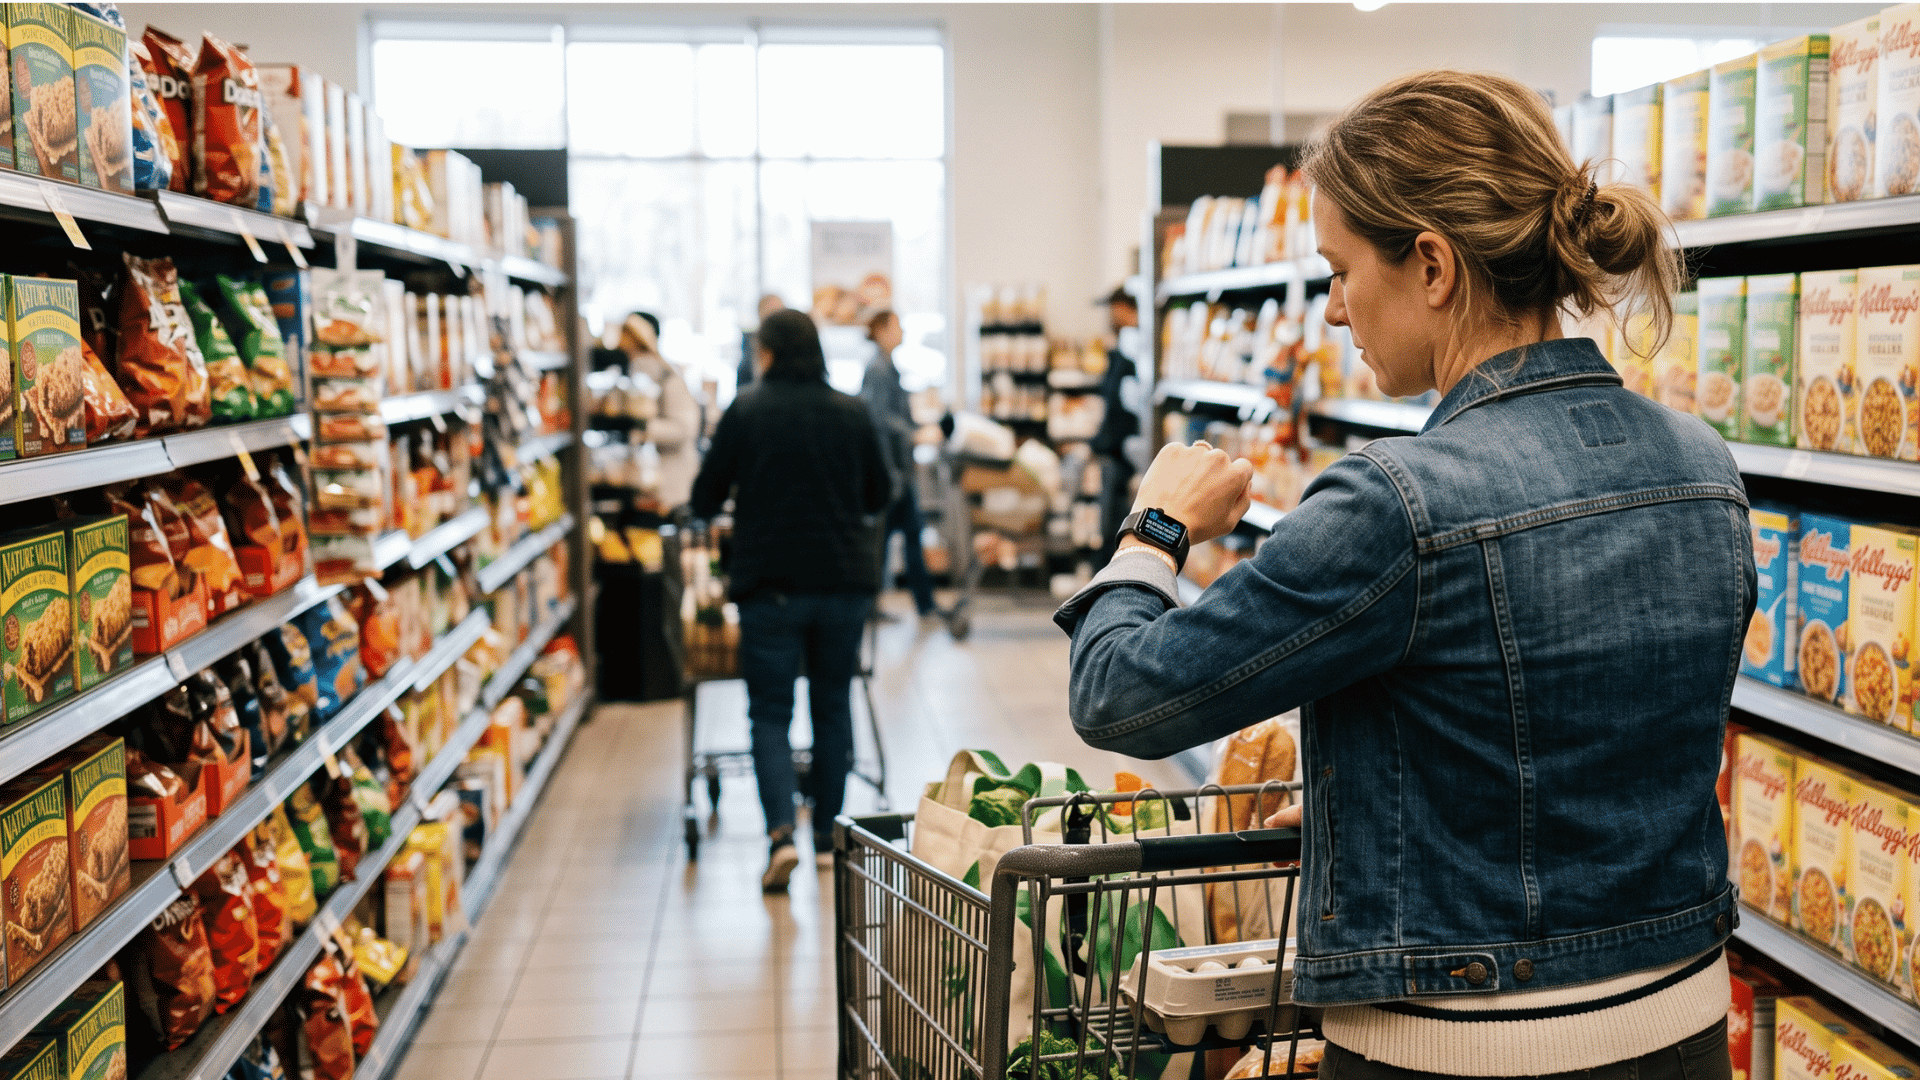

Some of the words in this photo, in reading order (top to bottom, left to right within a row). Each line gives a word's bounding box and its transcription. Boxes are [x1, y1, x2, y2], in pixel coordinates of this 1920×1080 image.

[1859, 283, 1920, 325] Kellogg's
[2, 546, 35, 588] NATURE
[35, 538, 62, 571] VALLEY
[77, 528, 104, 567] NATURE
[103, 522, 126, 551] VALLEY
[1851, 544, 1913, 592] Kellogg's
[2, 801, 37, 851] NATURE
[35, 784, 62, 818] VALLEY
[1796, 777, 1850, 827] Kellogg's
[1850, 801, 1908, 855] Kellogg's
[71, 1014, 100, 1068] NATURE
[1777, 1021, 1832, 1077] Kellogg's
